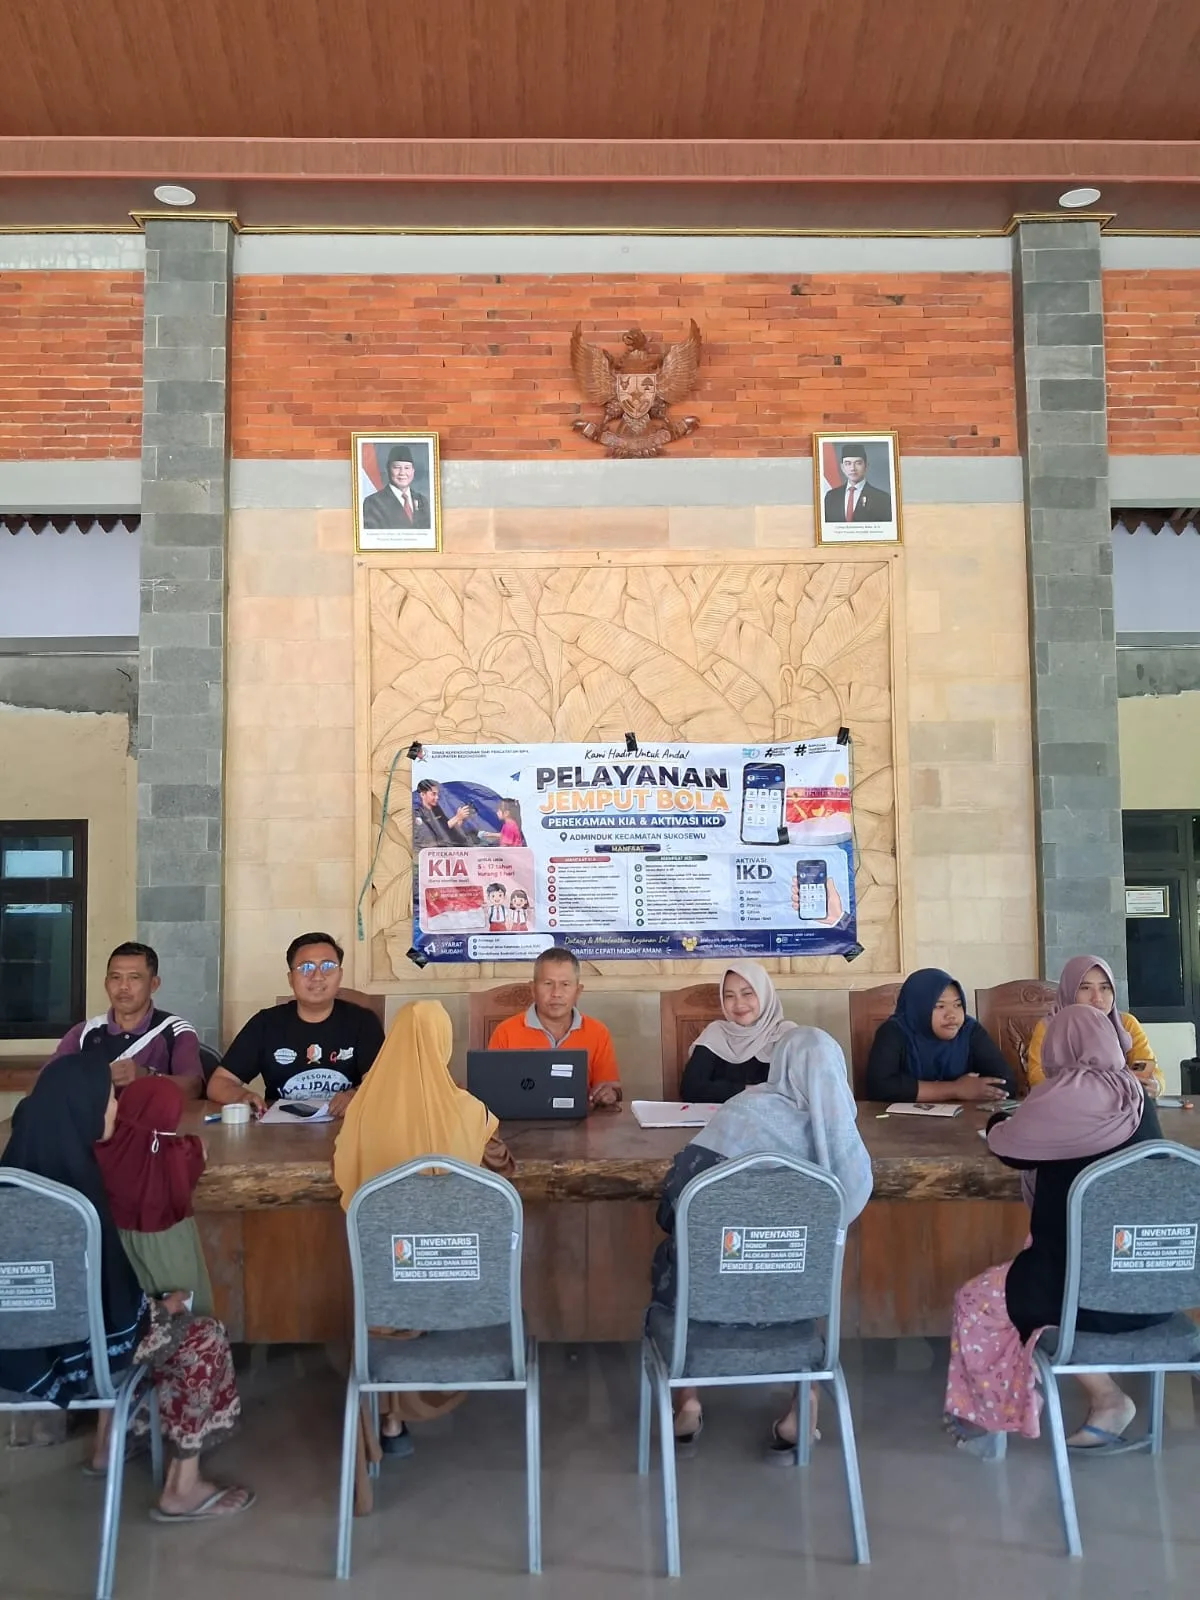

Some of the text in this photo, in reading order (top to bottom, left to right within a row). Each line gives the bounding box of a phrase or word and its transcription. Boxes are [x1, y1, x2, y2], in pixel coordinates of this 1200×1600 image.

[585, 749, 605, 759] Kami
[635, 748, 659, 758] Untuk
[662, 749, 689, 759] Anda!
[537, 765, 728, 790] PELAYANAN
[540, 789, 729, 812] JEMPUT BOLA
[548, 816, 720, 827] PEREKAMAN KIA & AKTIVASI IKD
[569, 833, 612, 841] ADMINDUK
[429, 859, 468, 877] KIA
[736, 865, 772, 880] IKD
[302, 1074, 332, 1082] PESONA
[750, 1230, 800, 1239] INVENTARIS
[1141, 1228, 1191, 1237] INVENTARIS
[420, 1237, 472, 1246] INVENTARIS
[722, 1262, 753, 1270] PEMDES
[1113, 1260, 1144, 1268] PEMDES
[0, 1265, 46, 1275] VENTARIS
[395, 1270, 427, 1278] PEMDES
